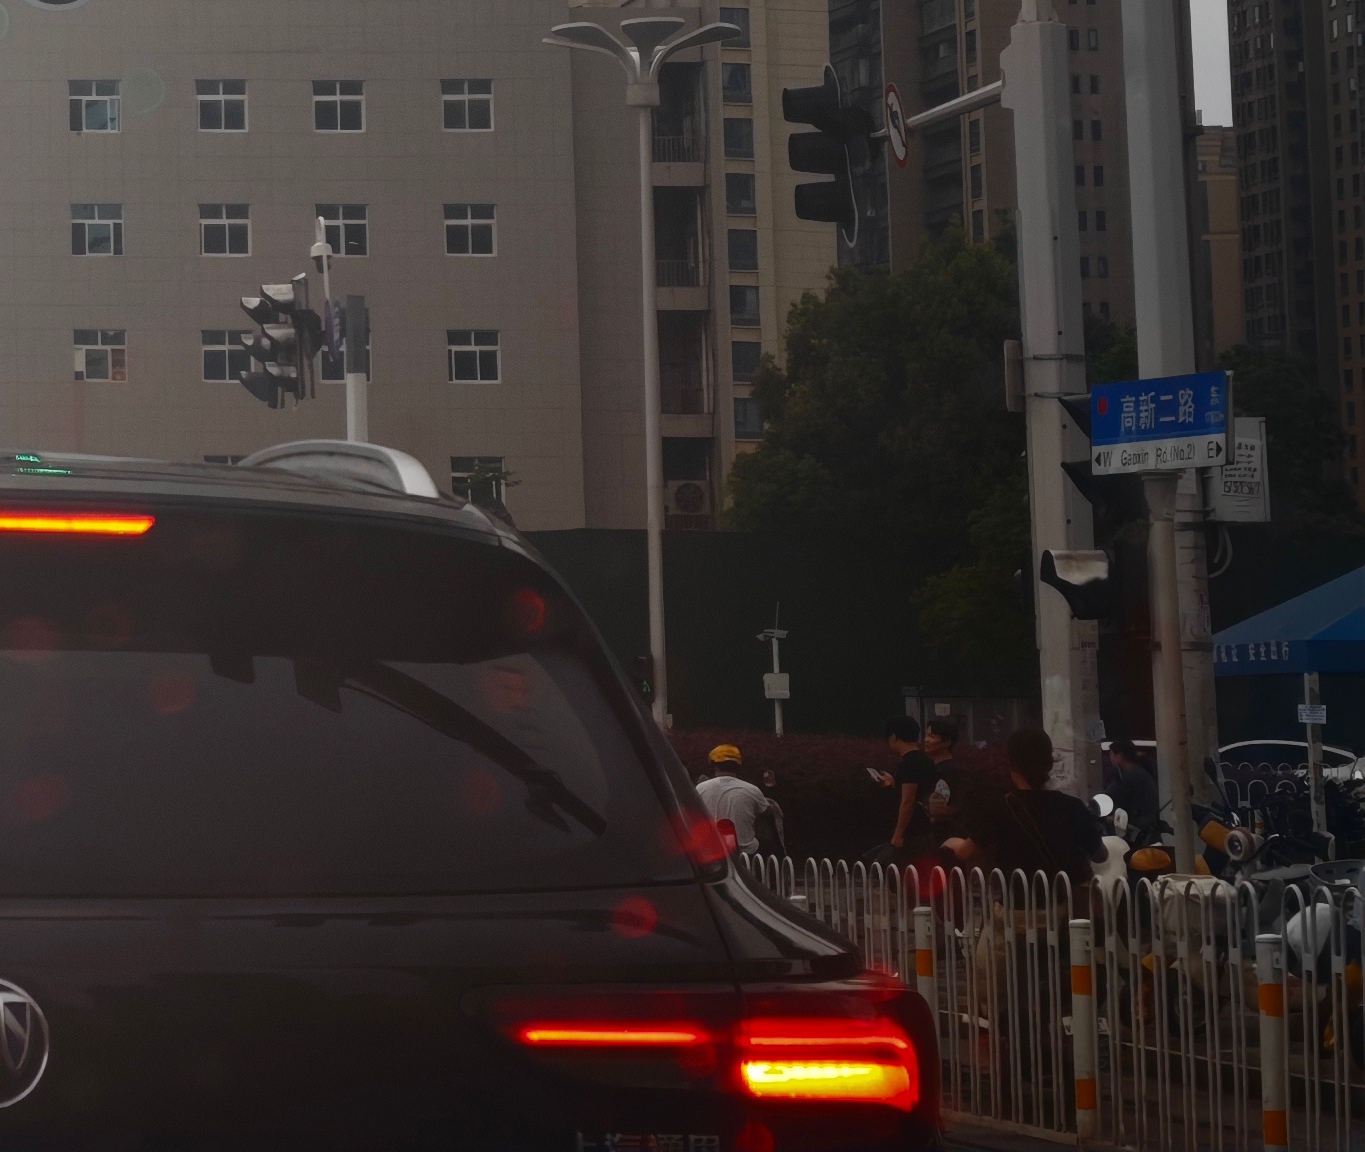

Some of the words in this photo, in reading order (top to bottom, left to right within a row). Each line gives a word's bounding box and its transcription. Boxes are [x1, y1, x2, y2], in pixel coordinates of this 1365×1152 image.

[1120, 387, 1196, 433] 高新二路
[1102, 450, 1113, 467] W
[1207, 441, 1215, 459] E
